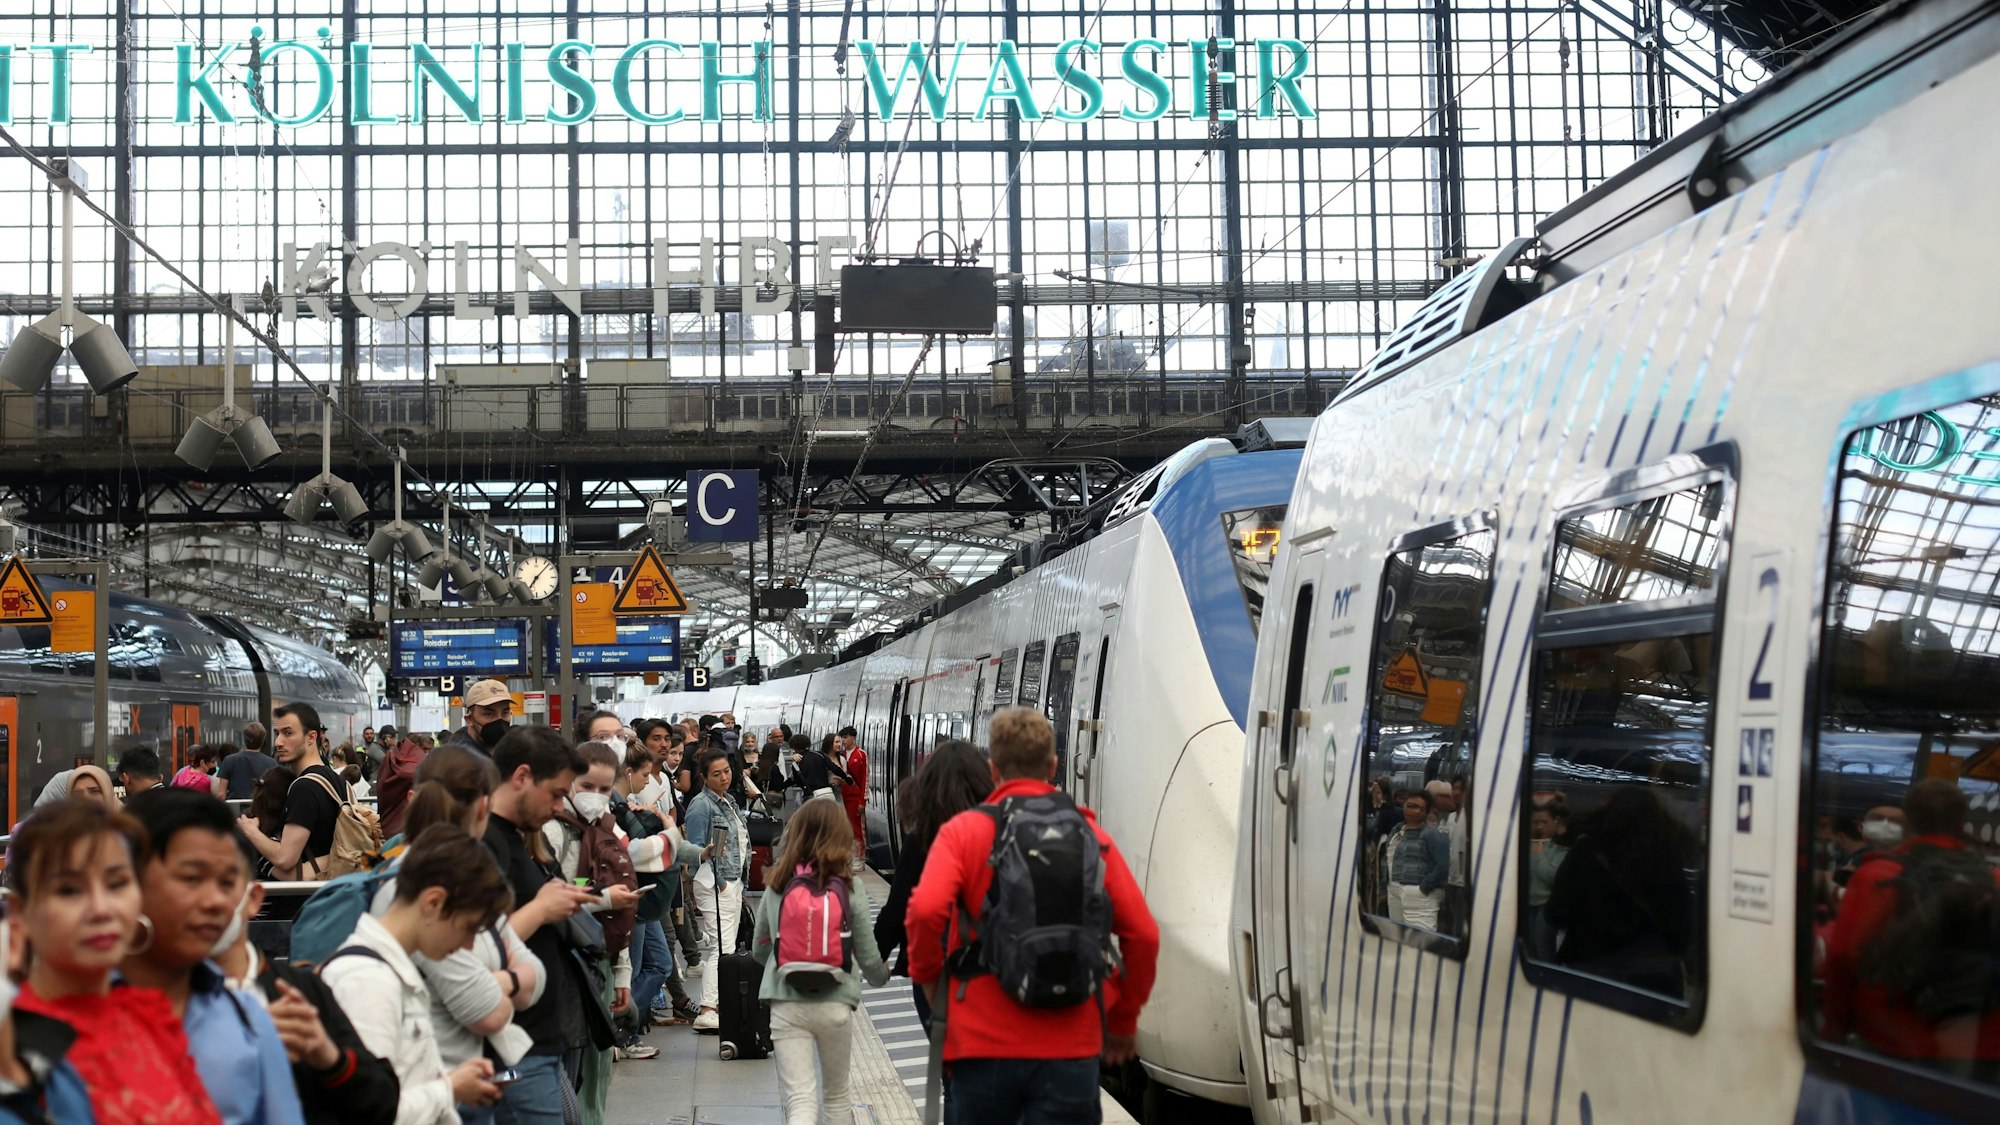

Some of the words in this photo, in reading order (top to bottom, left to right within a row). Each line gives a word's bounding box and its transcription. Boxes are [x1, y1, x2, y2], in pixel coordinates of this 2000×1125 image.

[173, 25, 775, 127] KÖLNISCH
[854, 37, 1317, 124] WASSER
[282, 237, 580, 322] KÖLN
[697, 472, 736, 526] C
[609, 567, 626, 590] 4
[423, 639, 452, 647] Roisdorf
[1748, 567, 1779, 701] 2
[440, 675, 455, 692] B
[692, 667, 707, 687] B
[379, 696, 389, 708] A
[36, 738, 42, 764] 2
